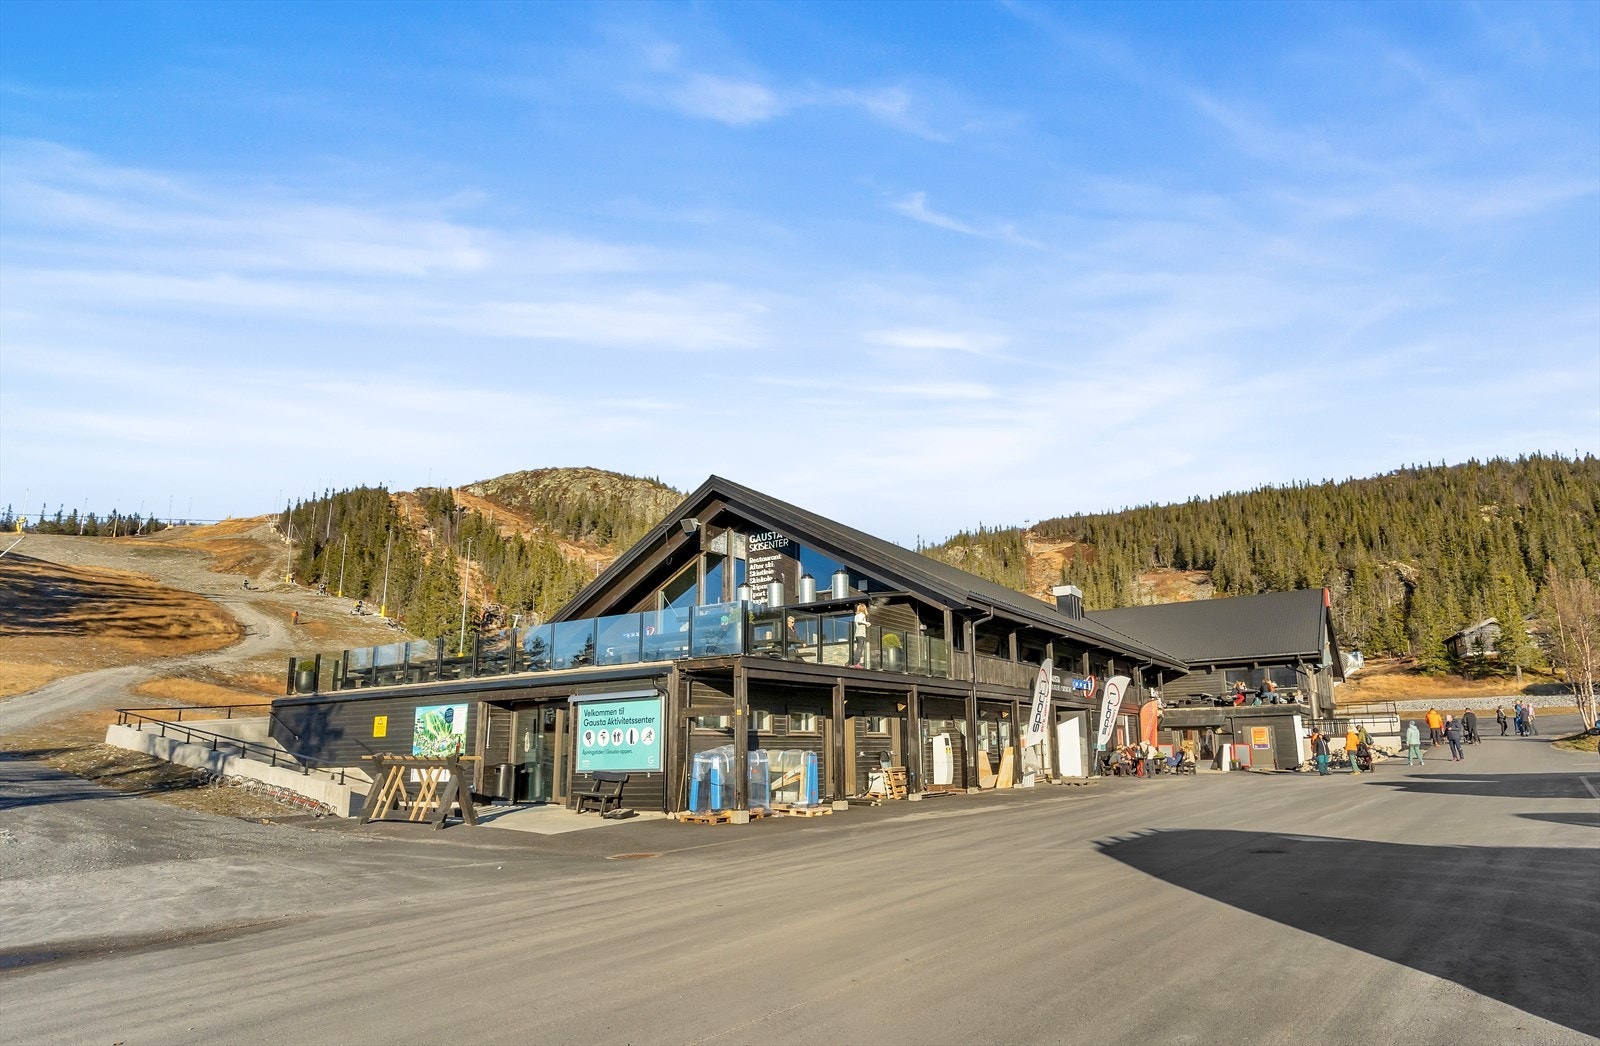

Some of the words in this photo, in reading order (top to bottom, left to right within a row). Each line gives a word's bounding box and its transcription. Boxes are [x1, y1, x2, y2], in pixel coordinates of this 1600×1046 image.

[749, 531, 783, 543] GAUSTA
[749, 538, 789, 552] SKISENTER
[749, 554, 782, 563] Restaurant
[583, 709, 617, 717] Velkommen
[1032, 689, 1046, 733] sport
[583, 718, 607, 727] Gausta
[607, 716, 655, 726] Aktivitetssenter
[1101, 700, 1113, 735] sport
